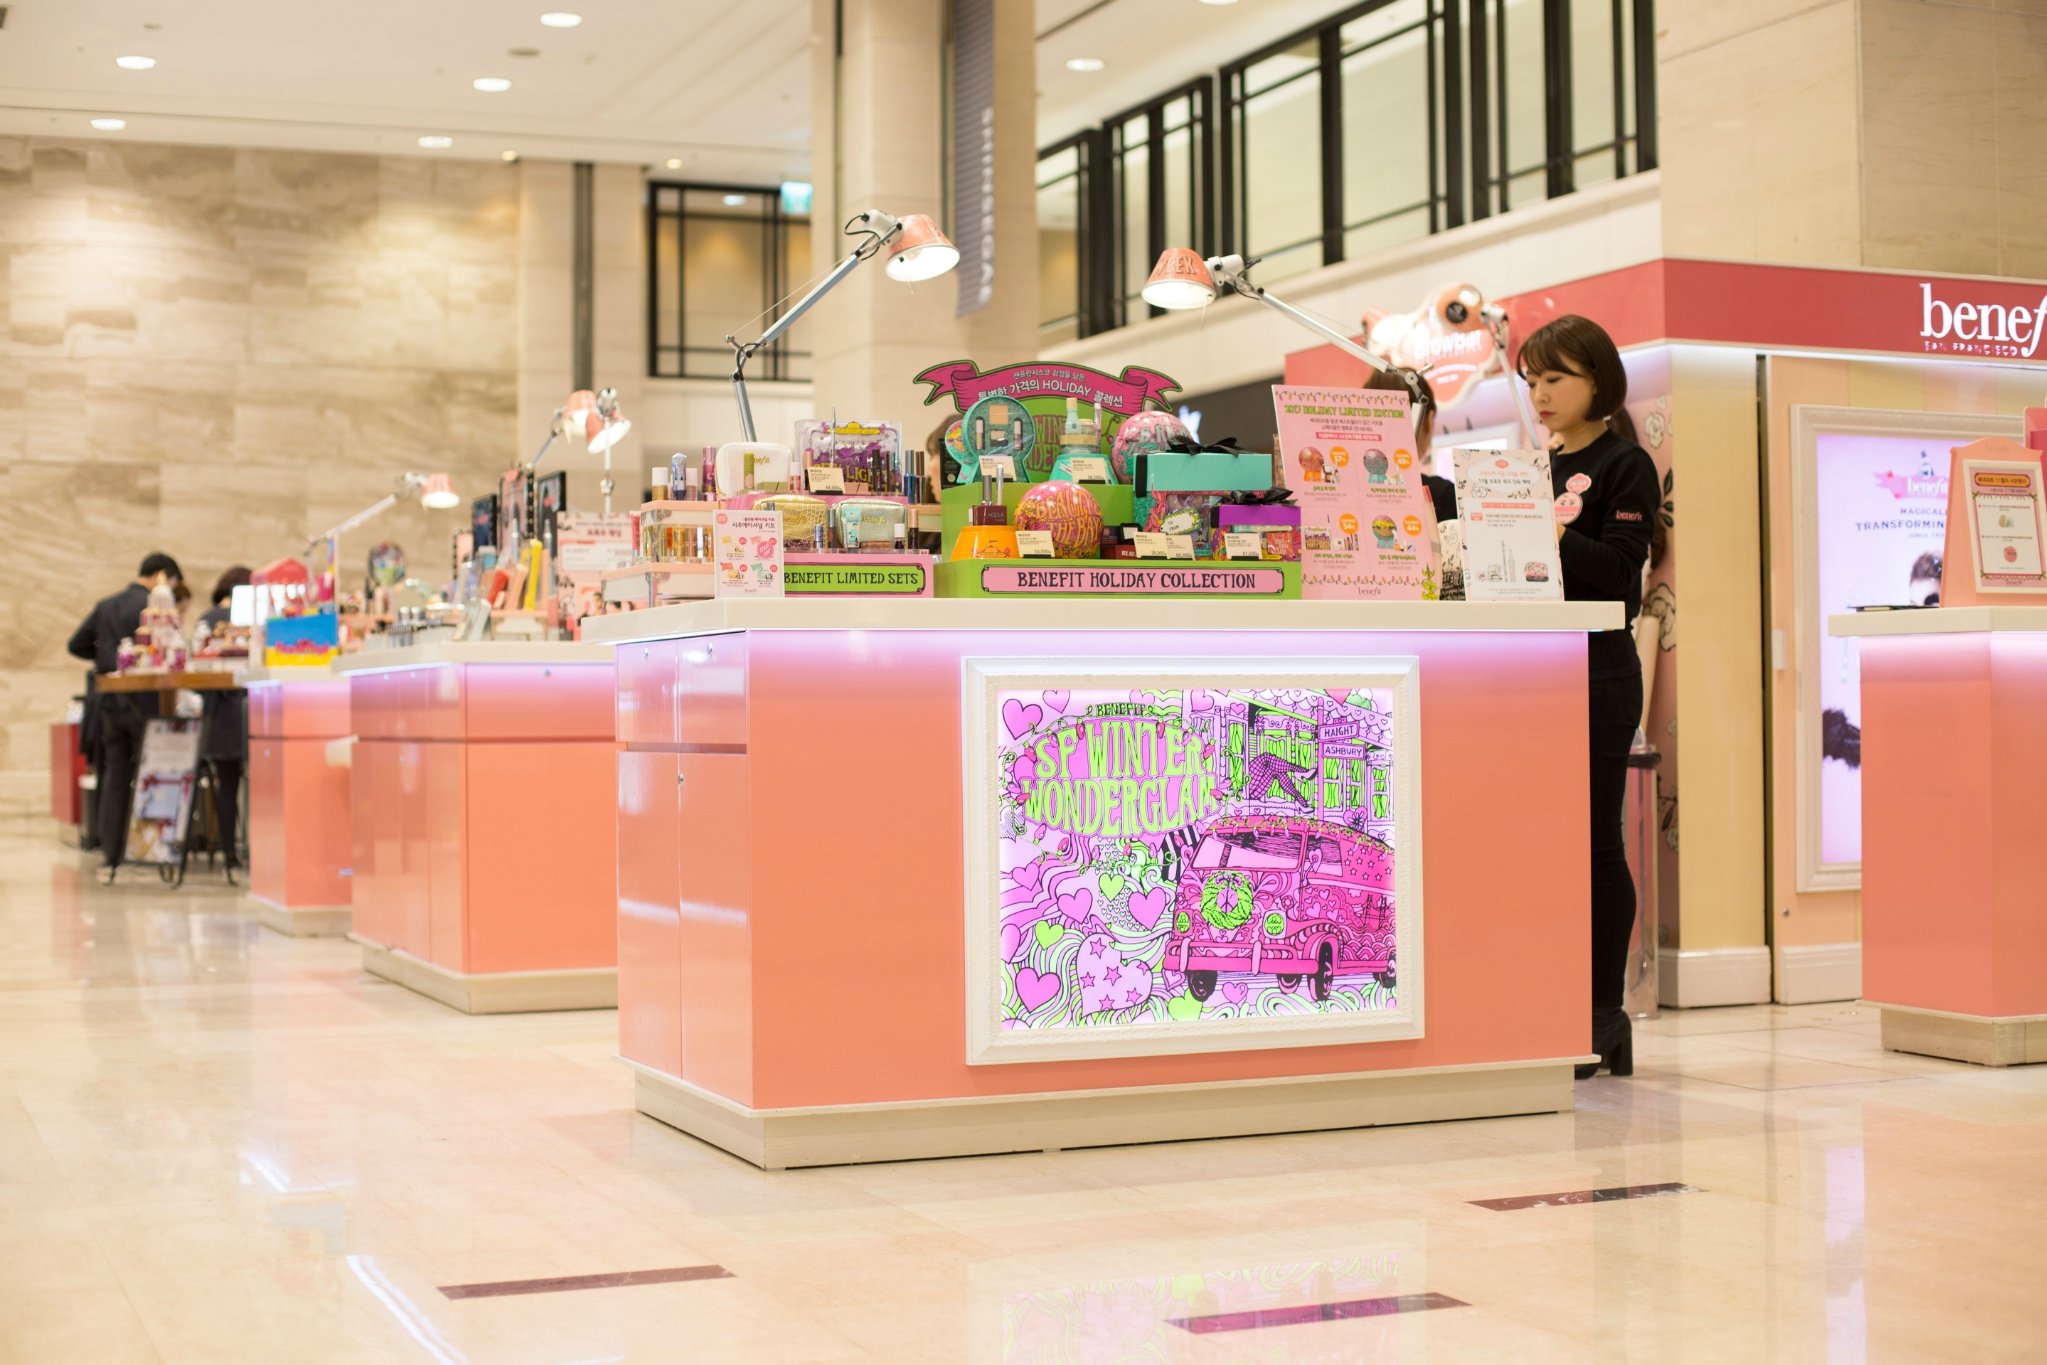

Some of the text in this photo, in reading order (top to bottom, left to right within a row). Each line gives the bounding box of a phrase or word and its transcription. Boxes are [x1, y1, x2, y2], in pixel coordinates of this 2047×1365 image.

[1010, 380, 1040, 394] 가격의
[1042, 380, 1092, 397] HOLIDAY
[1093, 390, 1123, 408] 콜렉션
[1338, 407, 1373, 417] LIMITED
[784, 572, 833, 584] BENEFIT
[837, 572, 885, 585] LIMITED
[888, 572, 918, 585] SETS
[1017, 571, 1256, 589] BENEFIT HOLIDAY COLLECTION
[1096, 703, 1146, 717] BENEFIT
[1324, 725, 1354, 737] HAIGHT
[1034, 721, 1207, 779] SF WINTER
[1325, 746, 1363, 756] ASHBURY
[1021, 775, 1219, 836] WONDERGLAM
